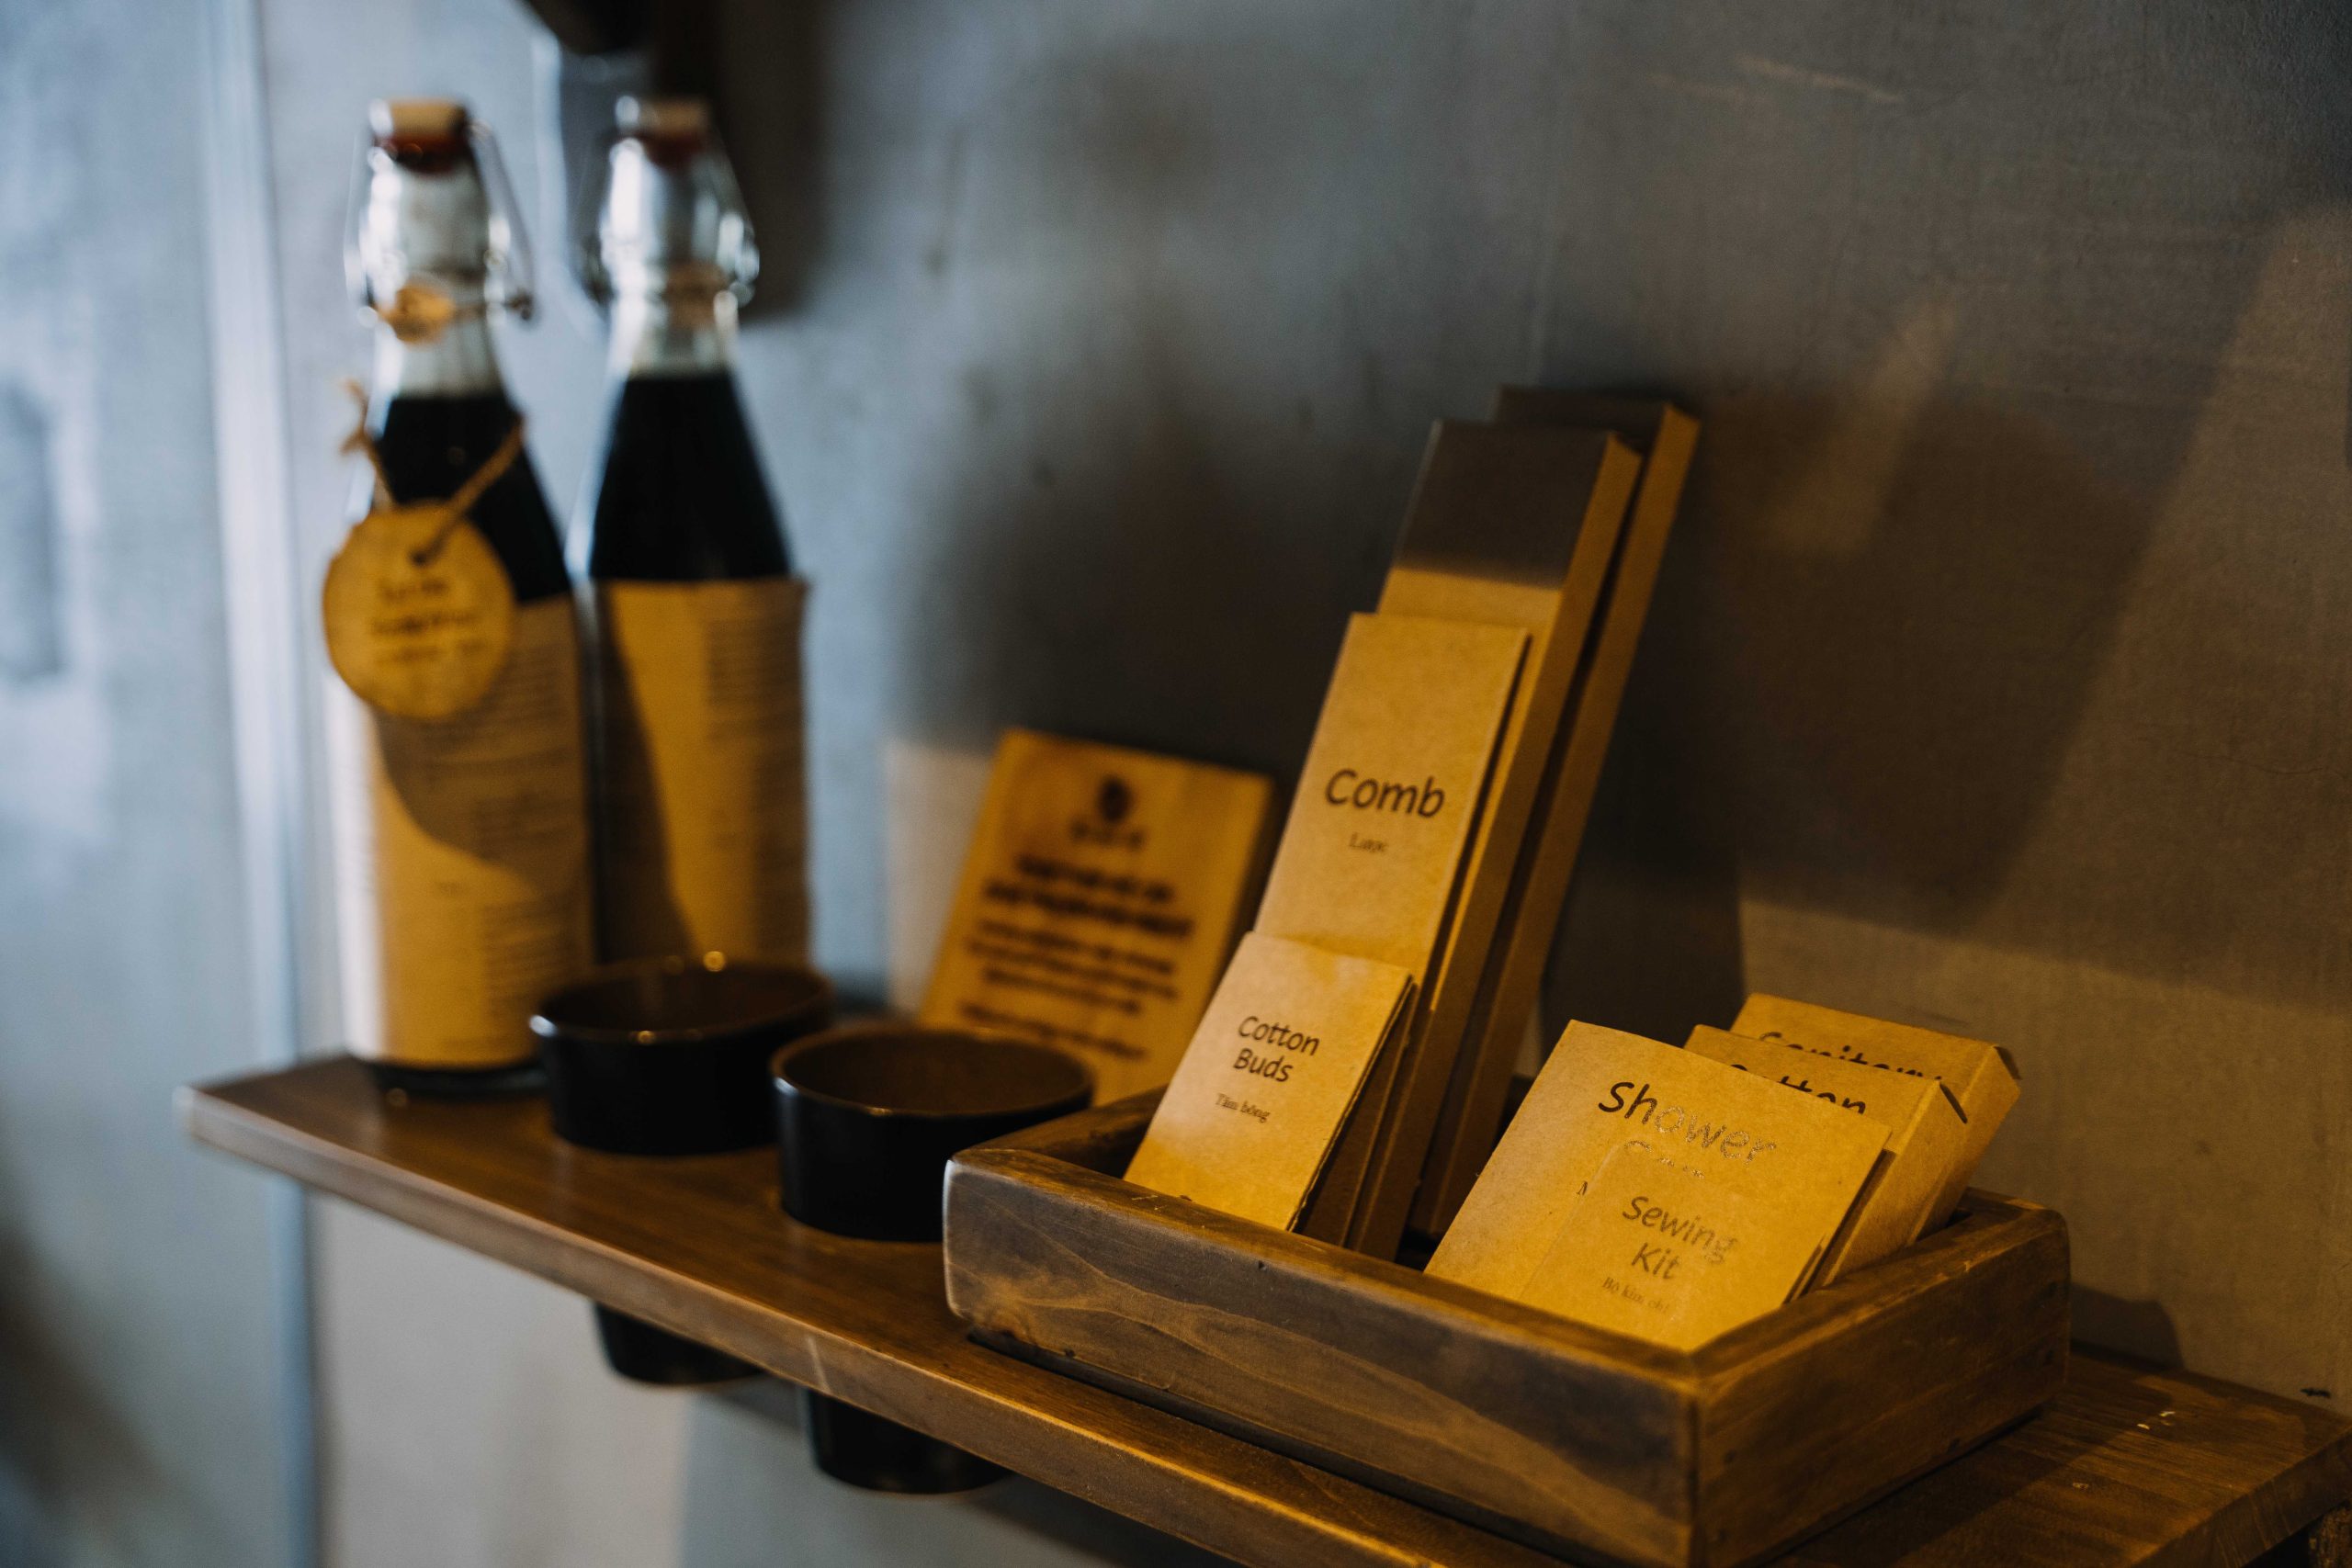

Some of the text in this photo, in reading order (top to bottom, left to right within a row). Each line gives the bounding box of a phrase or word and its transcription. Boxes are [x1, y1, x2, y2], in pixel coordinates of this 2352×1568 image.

[1325, 768, 1445, 818] Comb
[1238, 1015, 1321, 1057] Cotton
[1233, 1047, 1295, 1082] Buds
[1598, 1081, 1778, 1167] Shower
[1622, 1196, 1738, 1265] Sewing
[1631, 1243, 1679, 1279] Kit
